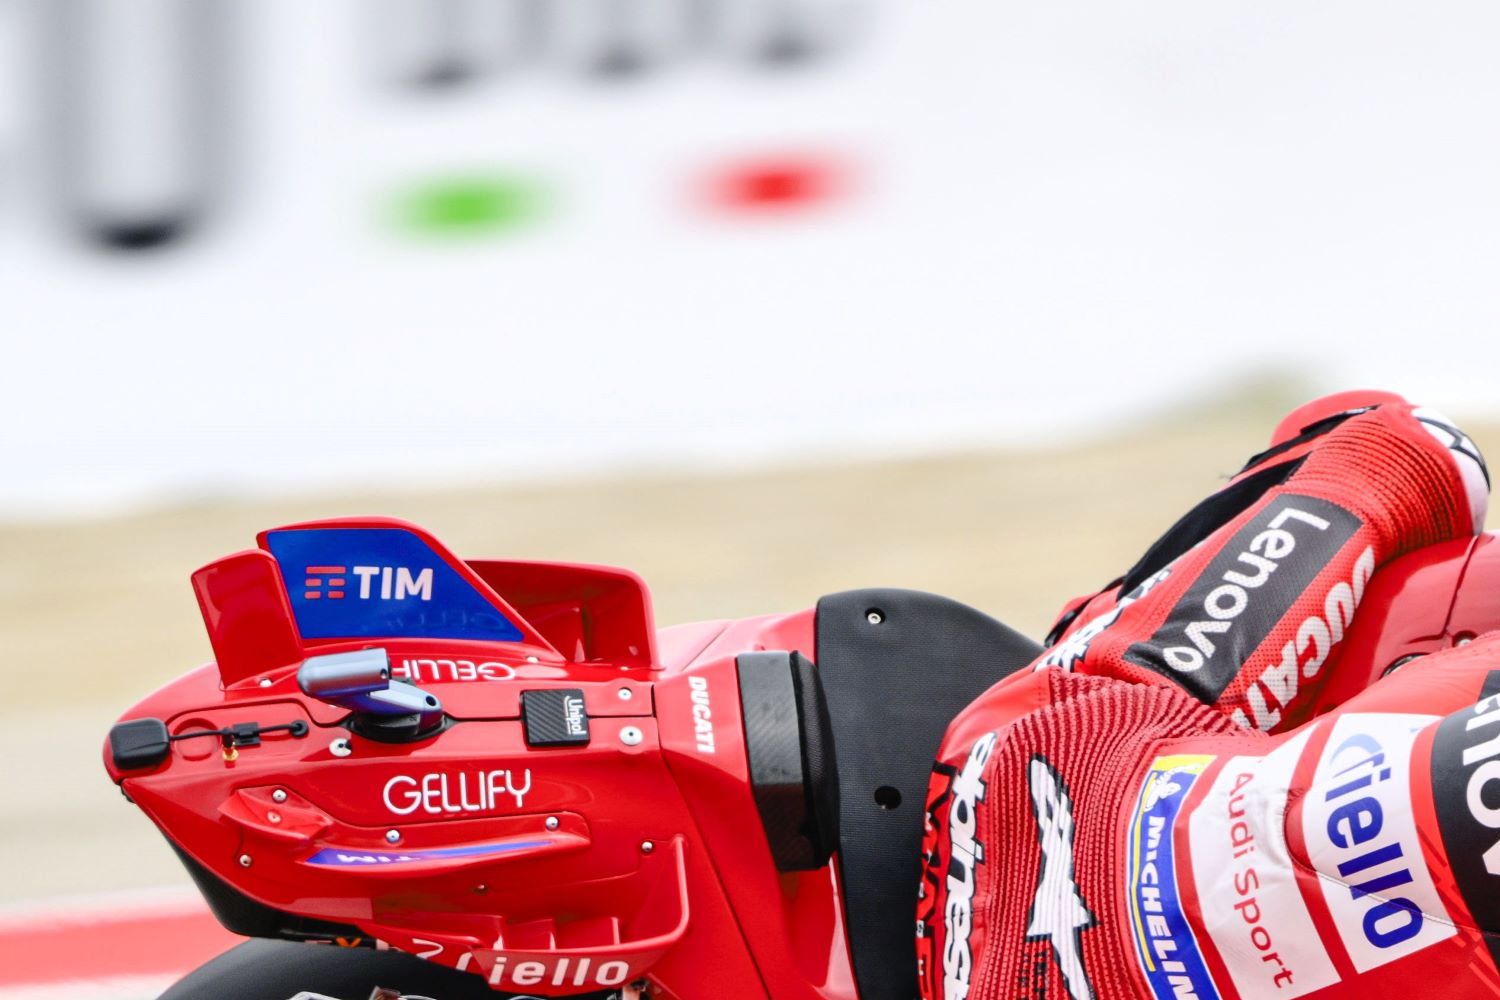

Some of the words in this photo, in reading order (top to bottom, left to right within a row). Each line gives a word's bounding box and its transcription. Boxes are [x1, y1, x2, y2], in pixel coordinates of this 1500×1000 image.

[352, 565, 434, 601] TIM
[1162, 507, 1332, 673] Lenovo
[392, 658, 517, 682] GELLIF
[567, 698, 588, 736] Unipol
[687, 675, 716, 754] DUCATI
[382, 768, 532, 815] GELLIFY
[1227, 771, 1256, 860] Audi
[1233, 869, 1295, 990] Sport
